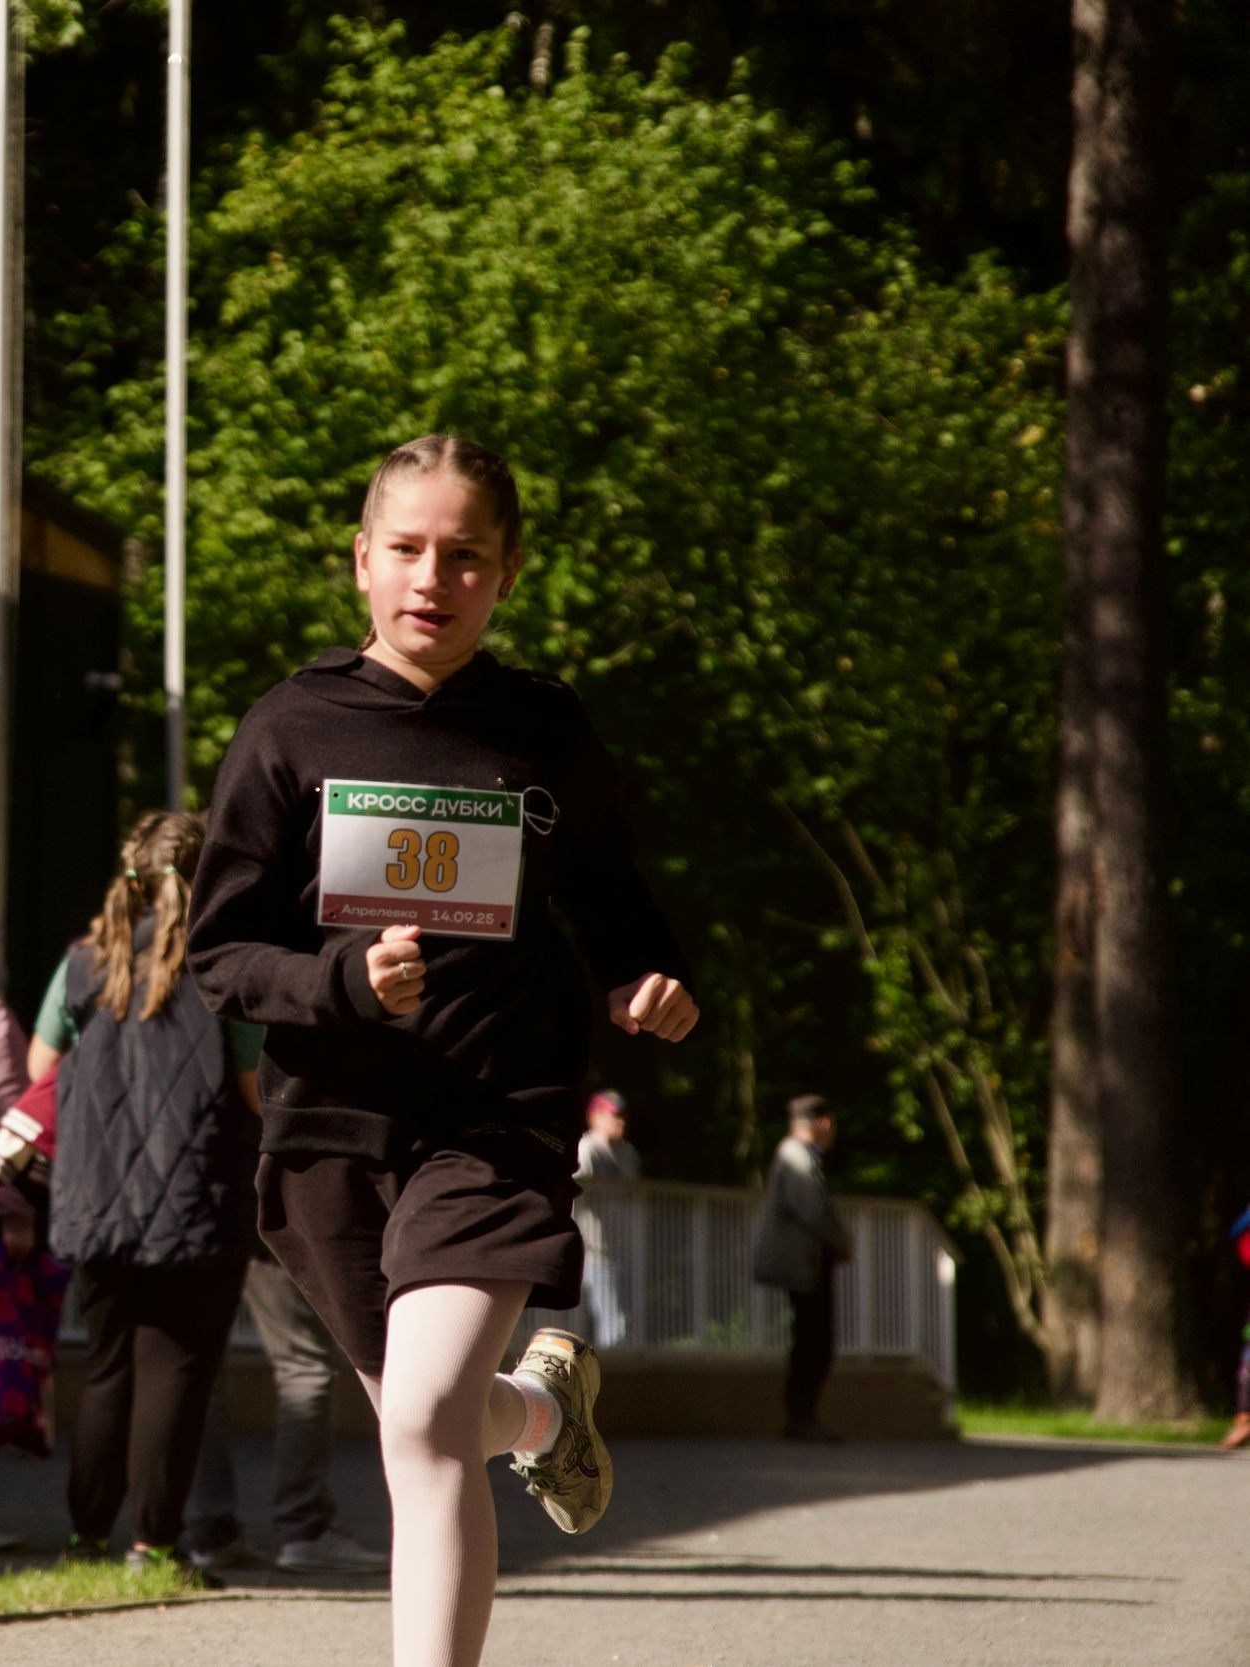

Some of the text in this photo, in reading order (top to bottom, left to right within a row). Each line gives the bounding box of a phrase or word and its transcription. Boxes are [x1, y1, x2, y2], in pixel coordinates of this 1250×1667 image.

[347, 792, 502, 818] КРОСС ДУБКИ
[386, 828, 460, 893] 38
[341, 903, 495, 925] Апрелевка 14.09.25
